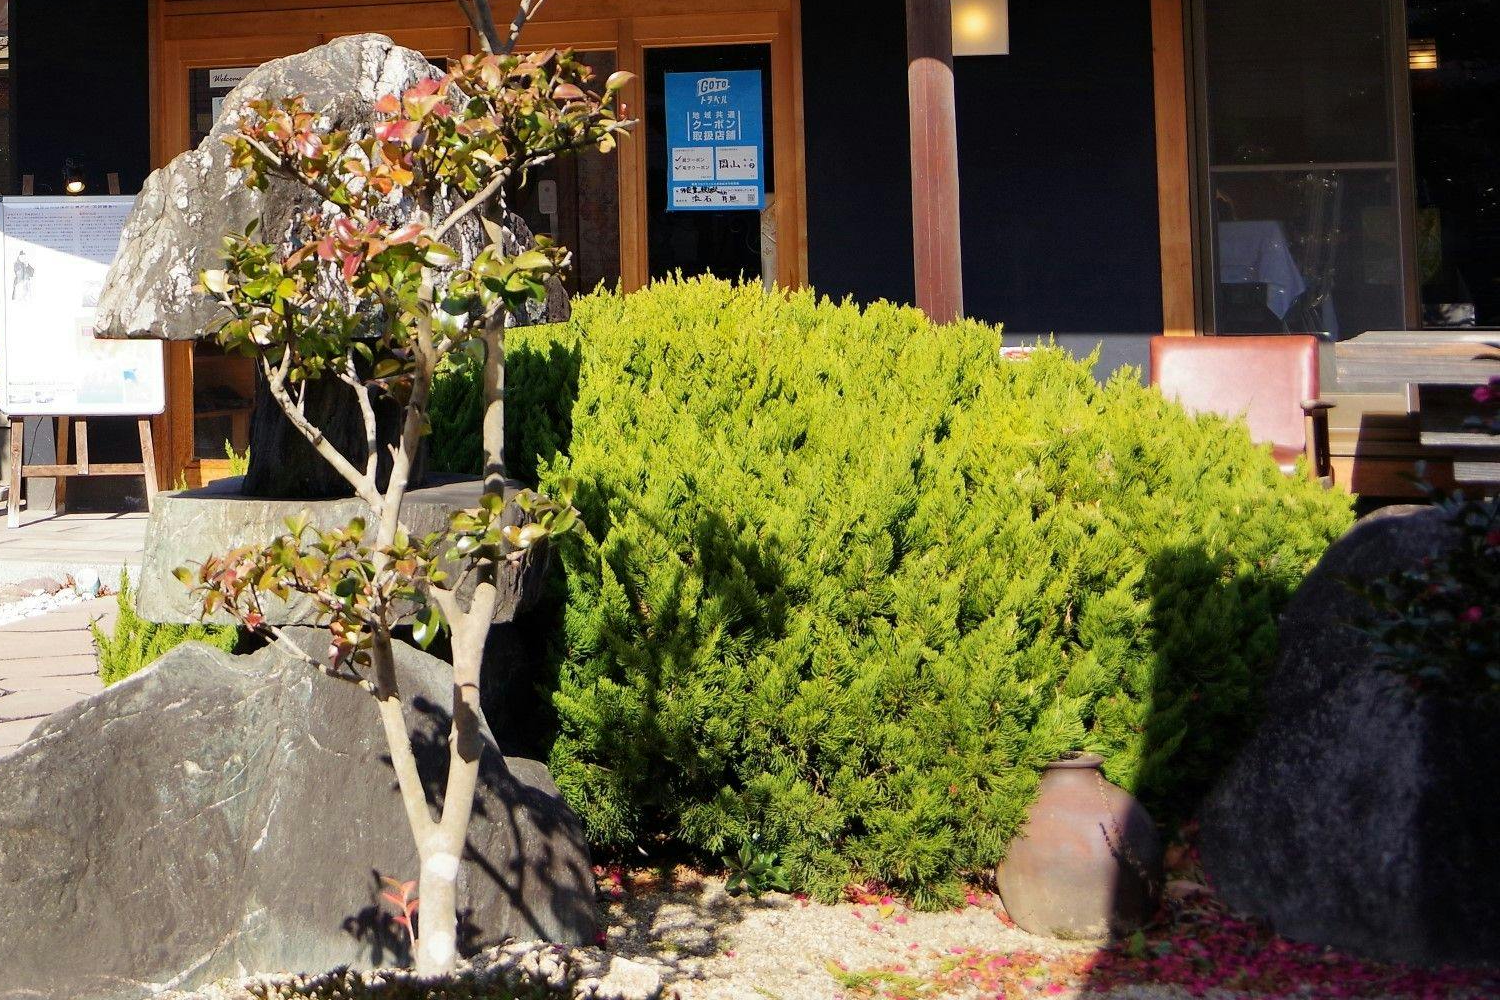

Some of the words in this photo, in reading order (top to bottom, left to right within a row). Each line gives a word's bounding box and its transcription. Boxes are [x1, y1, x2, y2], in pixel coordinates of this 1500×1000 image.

[701, 95, 728, 105] トラベル
[692, 110, 736, 119] 地域共通
[692, 119, 736, 130] クーポン
[692, 129, 737, 141] 取扱店舗
